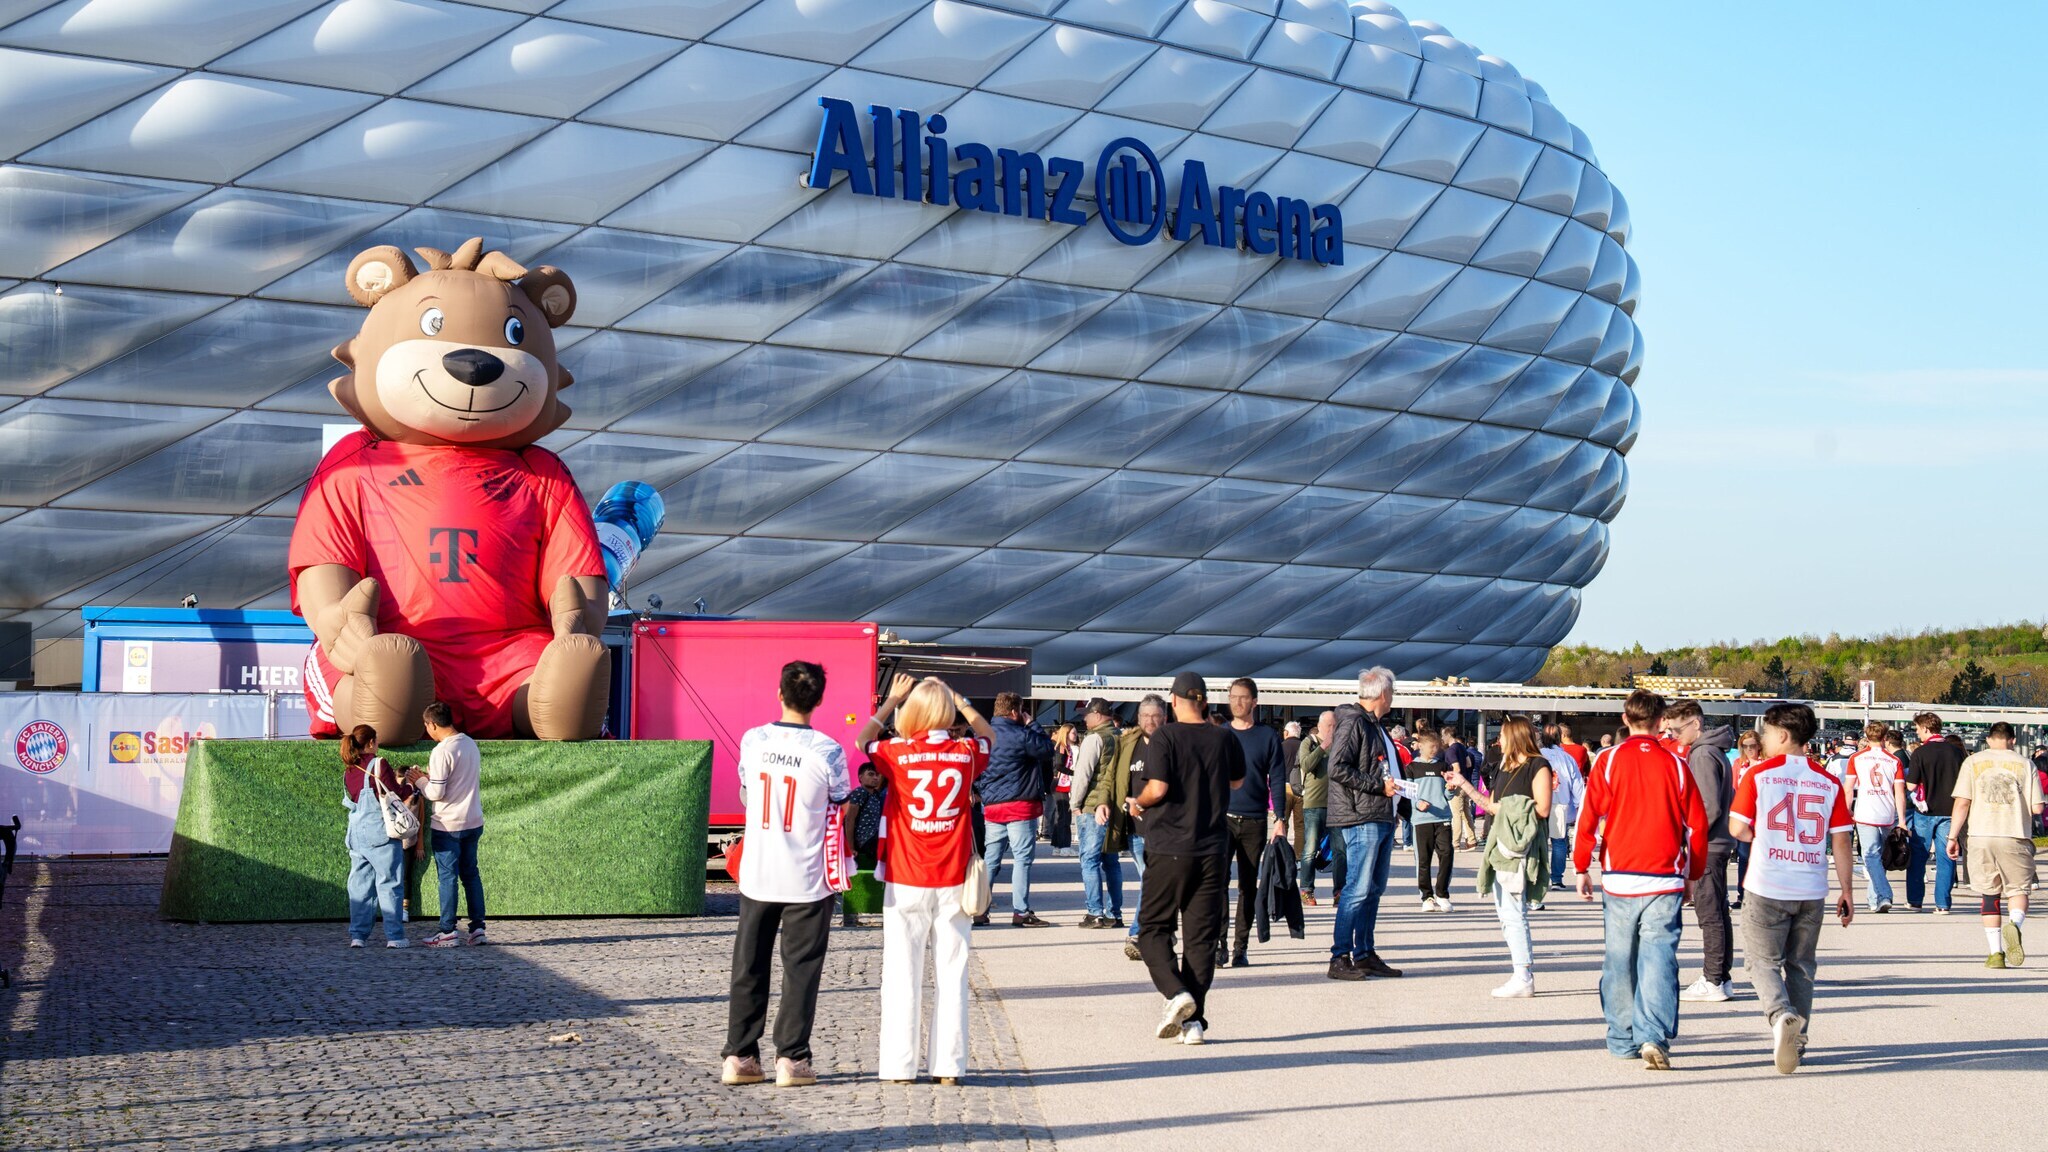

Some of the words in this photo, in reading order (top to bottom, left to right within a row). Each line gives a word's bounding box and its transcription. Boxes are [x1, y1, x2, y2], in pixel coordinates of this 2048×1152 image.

[809, 95, 1087, 227] Allianz
[1174, 158, 1345, 267] Arena
[429, 527, 479, 584] T
[241, 665, 299, 686] HIER
[19, 730, 31, 744] FC
[30, 723, 65, 744] BAYERN
[143, 731, 214, 755] Sask
[762, 751, 802, 768] COMAN
[897, 754, 908, 765] FC
[908, 752, 937, 764] BAYERN
[1772, 777, 1799, 787] BAYERN
[1869, 763, 1884, 788] 6
[759, 772, 797, 833] 11
[907, 767, 963, 819] 32
[1767, 792, 1825, 845] 45
